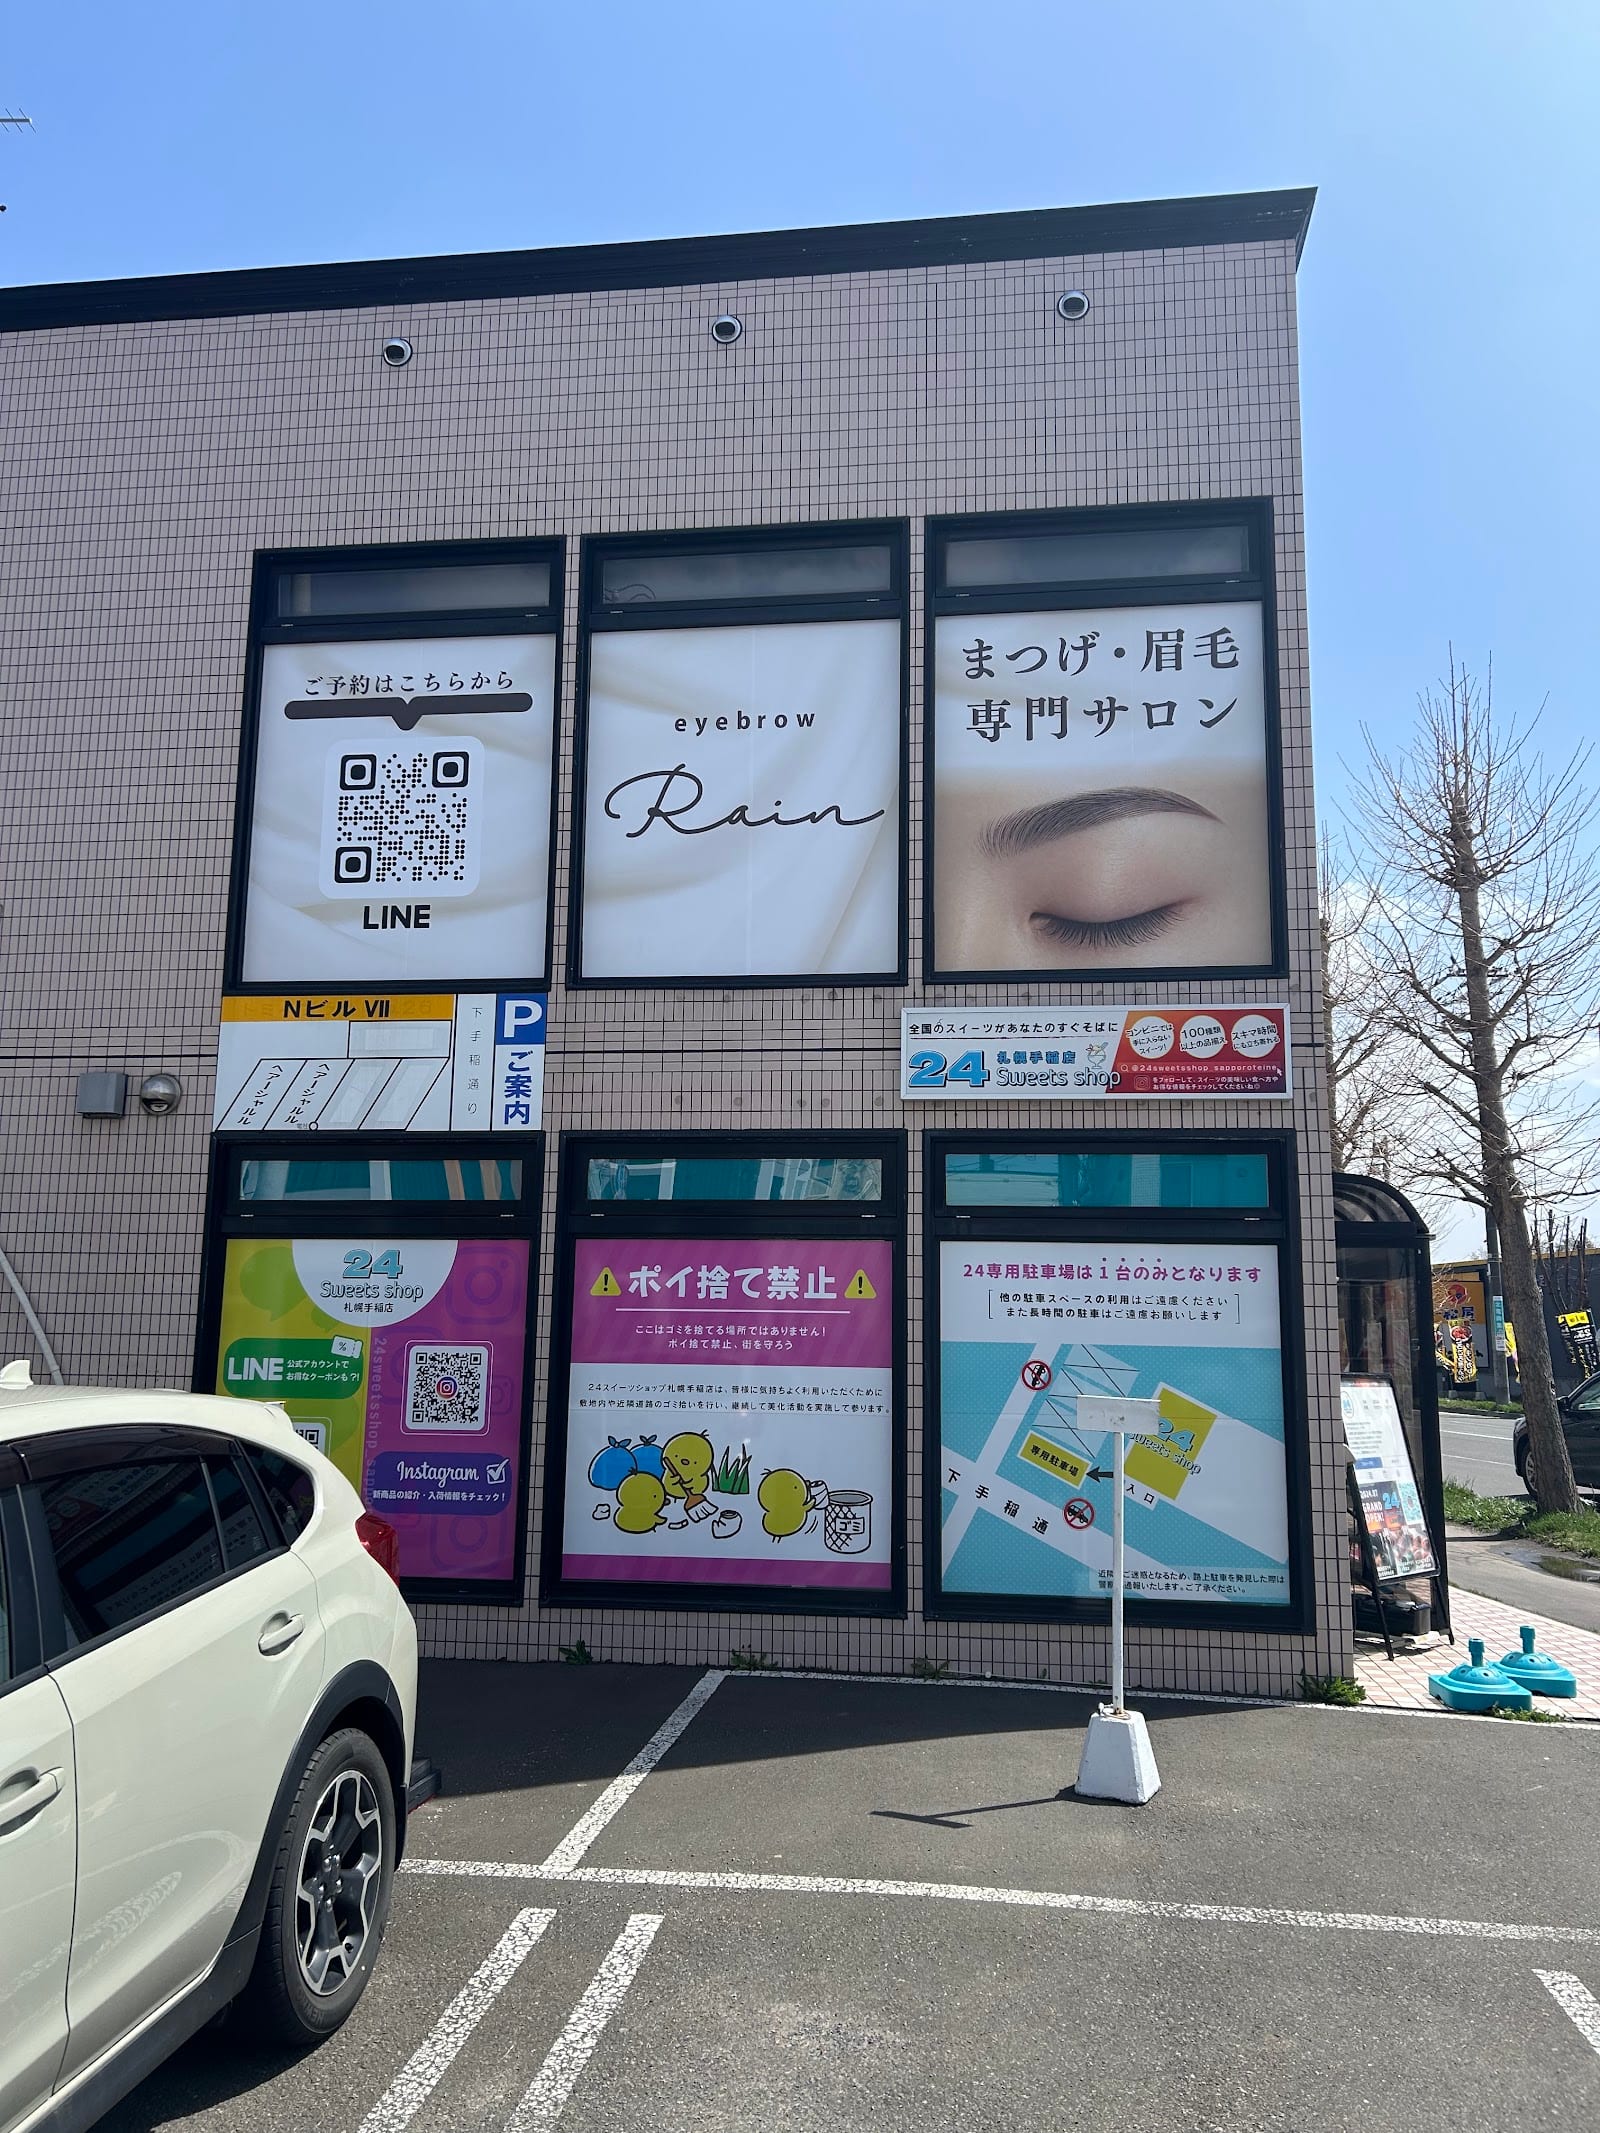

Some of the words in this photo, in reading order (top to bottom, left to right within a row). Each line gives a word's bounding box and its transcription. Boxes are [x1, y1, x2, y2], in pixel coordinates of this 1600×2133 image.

[962, 626, 1240, 680] まつげ・眉毛
[304, 670, 514, 697] ご予約はこちらから
[674, 710, 816, 737] eyebrow
[966, 695, 1239, 743] 専門サロン
[604, 763, 885, 838] Rain
[362, 904, 431, 930] LINE
[283, 999, 357, 1019] Nビル
[502, 999, 543, 1039] P
[908, 1021, 1119, 1036] 全国のスイーツがあなたのすぐそばに
[1126, 1022, 1174, 1039] コンビニでは
[1181, 1025, 1222, 1039] 100種類
[1231, 1023, 1278, 1040] スキマ時間
[466, 1006, 482, 1115] 下手稲通り
[908, 1049, 991, 1088] 24
[996, 1050, 1077, 1065] 札幌手稲店
[503, 1050, 534, 1126] ご案内
[996, 1067, 1068, 1087] Sweets
[1072, 1067, 1122, 1089] shop
[342, 1248, 404, 1280] 24
[962, 1263, 1262, 1283] 24専用駐車場は1台のみとなります
[320, 1280, 380, 1299] Sweets
[384, 1281, 424, 1303] shop
[627, 1264, 838, 1301] ポイ捨て禁止
[344, 1302, 394, 1313] 札幌手稲店
[999, 1292, 1229, 1308] 他の駐車スペースの利用はご遠慮ください
[1006, 1307, 1223, 1321] また長時間の駐車はご遠慮お願いします
[635, 1324, 827, 1337] ここはゴミを捨てる場所ではありません!
[668, 1338, 793, 1351] ポイ捨て禁止、街を守ろう
[227, 1357, 285, 1381] LINE
[287, 1359, 350, 1370] 公式アカウントで
[1029, 1444, 1079, 1478] 専用駐車場
[1173, 1453, 1202, 1475] shop
[396, 1461, 480, 1488] Instagram
[948, 1467, 1049, 1535] 下手稲通
[1126, 1484, 1155, 1505] 入口
[1382, 1491, 1401, 1510] 24
[838, 1520, 863, 1533] ゴミ
